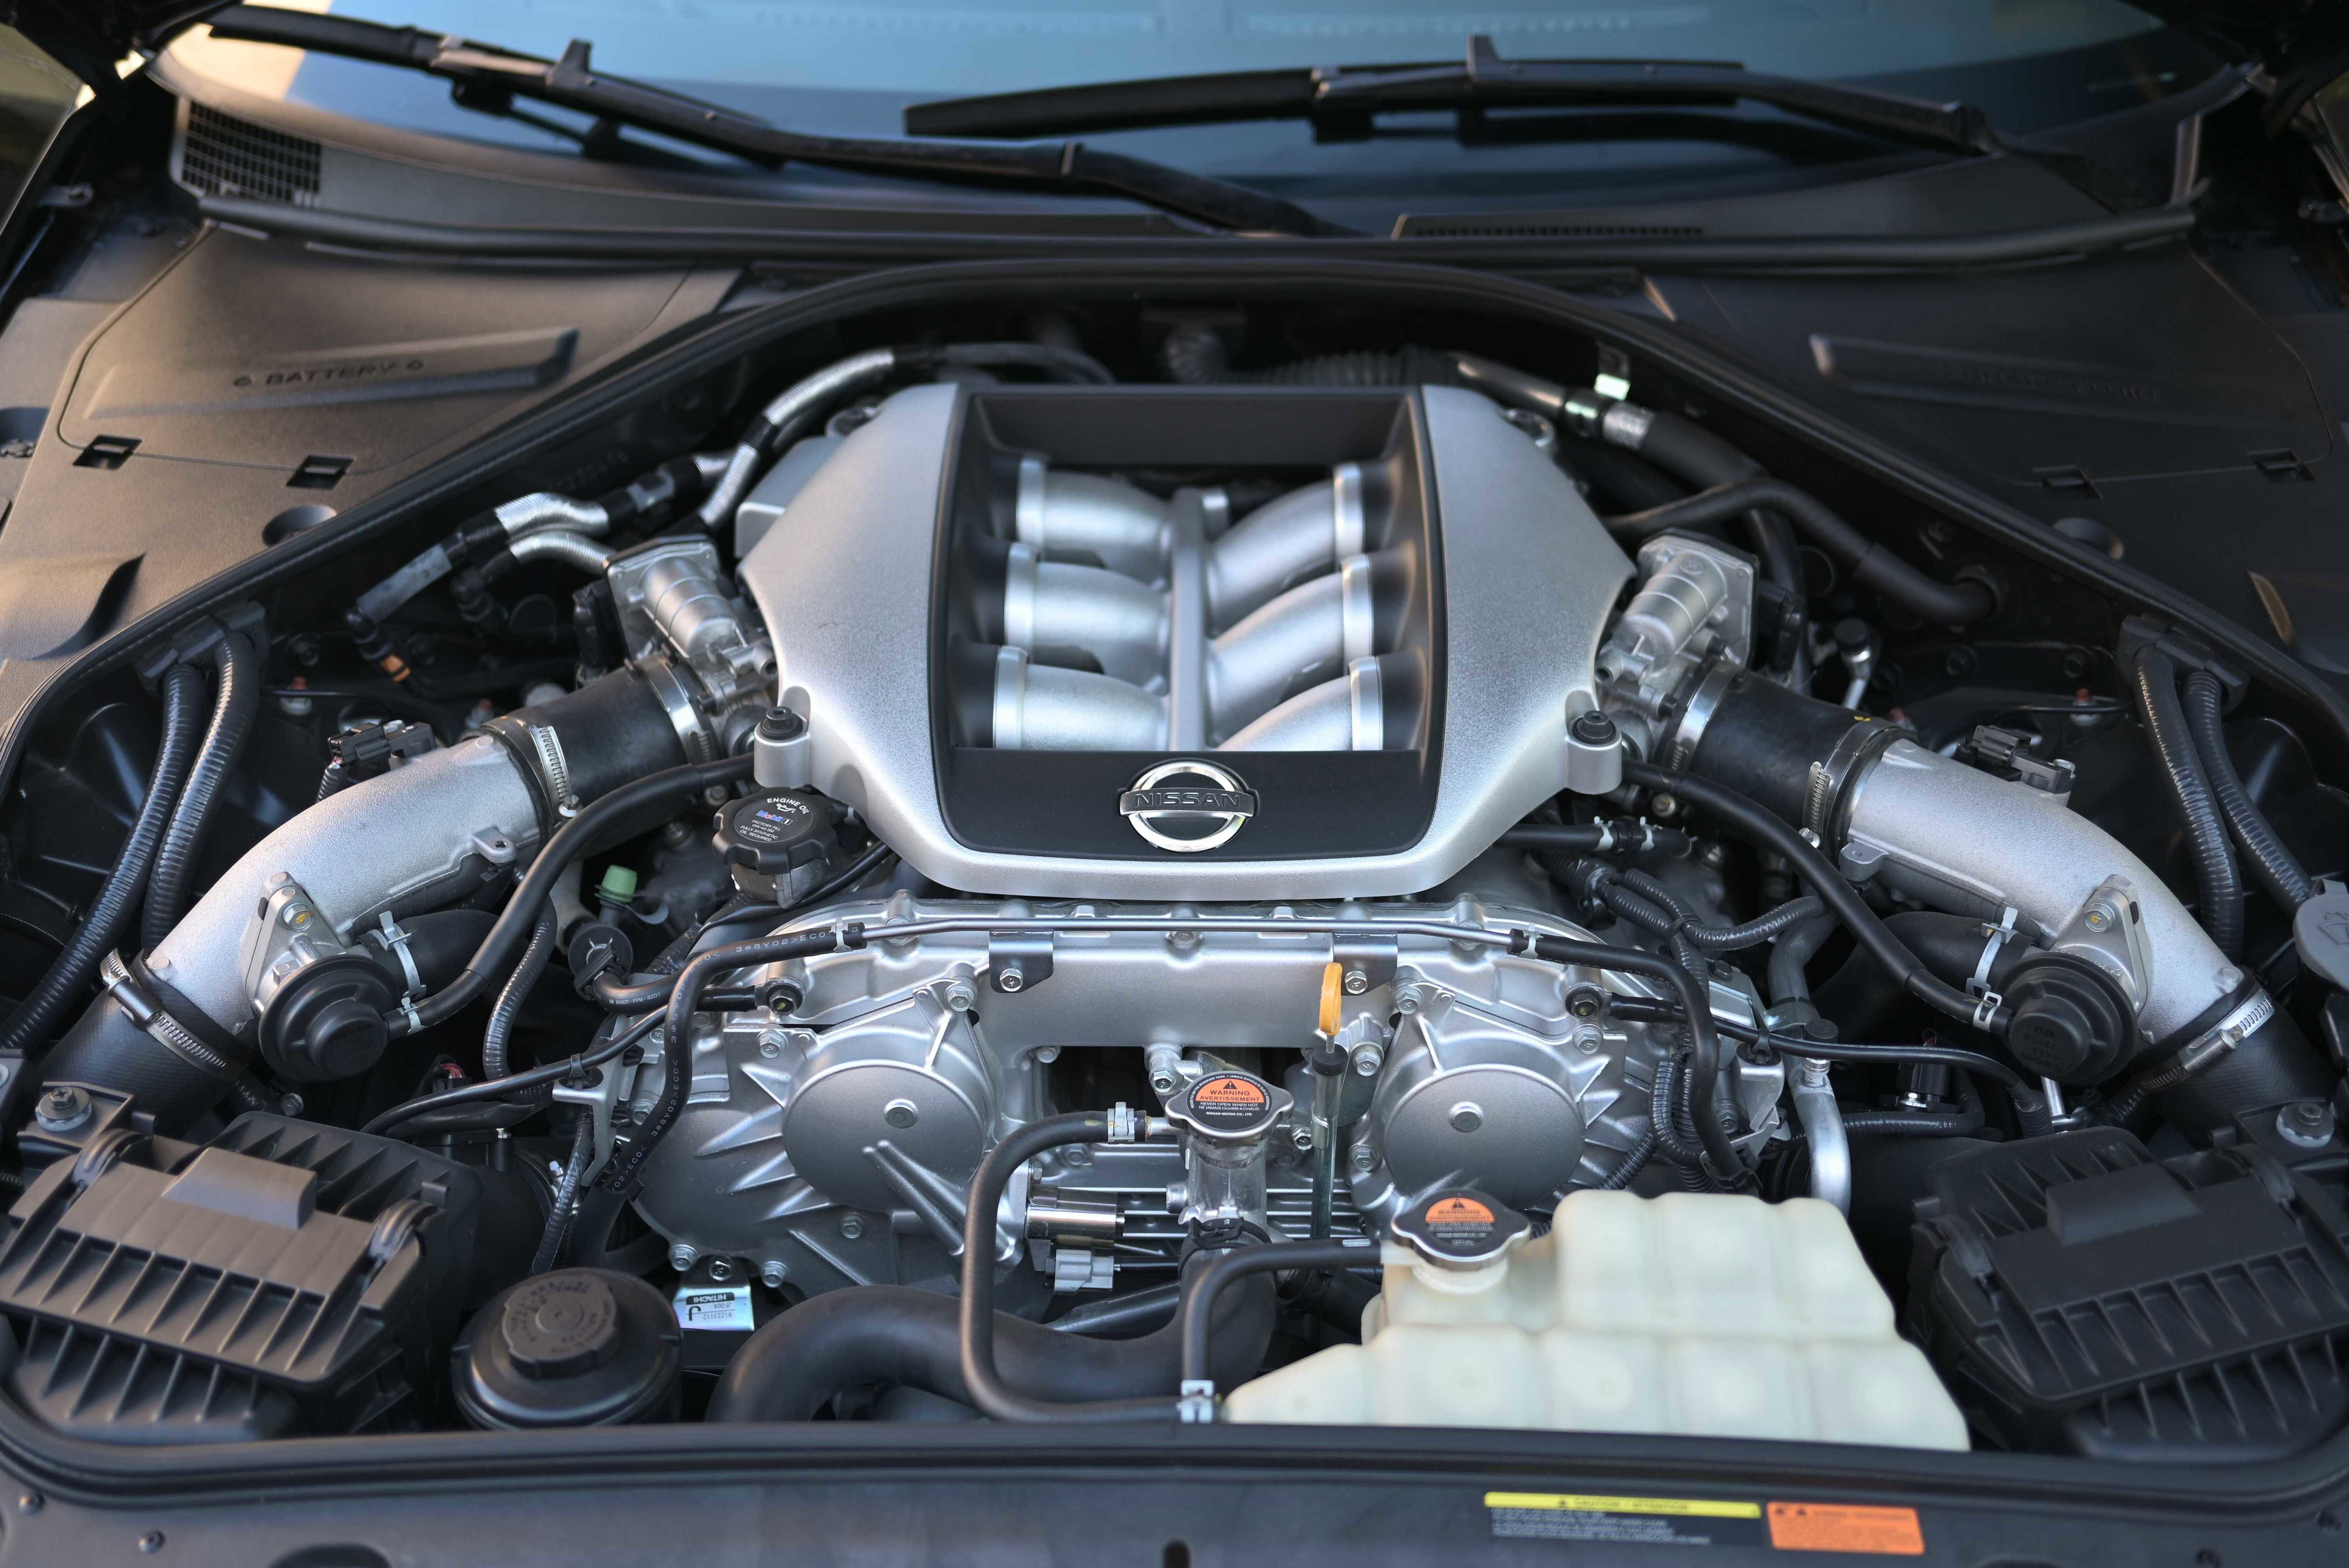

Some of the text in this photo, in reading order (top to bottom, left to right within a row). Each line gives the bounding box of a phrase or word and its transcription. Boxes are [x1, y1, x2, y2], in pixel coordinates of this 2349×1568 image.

[265, 361, 397, 385] BATTERY
[767, 797, 810, 814] ENGINE OIL
[1134, 792, 1240, 809] NISSAN
[756, 810, 784, 822] Mobil
[752, 819, 772, 828] FACTORY
[749, 832, 772, 842] REQUIRED
[753, 829, 779, 839] SYNTHETIC
[693, 1294, 727, 1303] HITACHI
